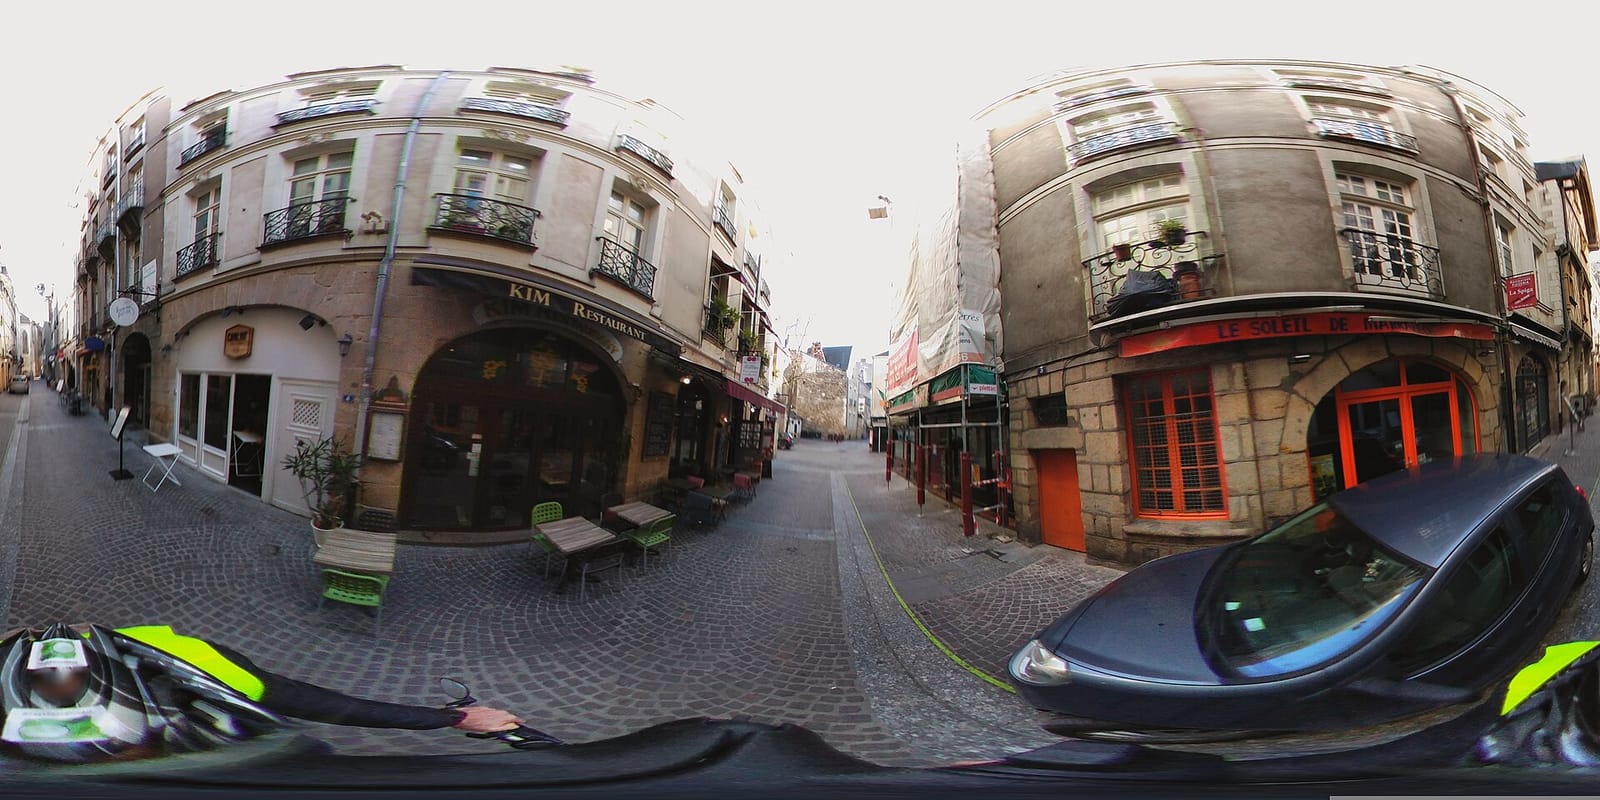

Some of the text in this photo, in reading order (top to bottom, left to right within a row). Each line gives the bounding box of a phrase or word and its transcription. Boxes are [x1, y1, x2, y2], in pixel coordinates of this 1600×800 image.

[1518, 287, 1534, 295] Spiga
[509, 283, 551, 306] KIM
[573, 302, 647, 341] RESTAURANT
[1217, 321, 1240, 338] LE
[1249, 317, 1312, 336] SOLEIL
[1329, 317, 1348, 331] DE
